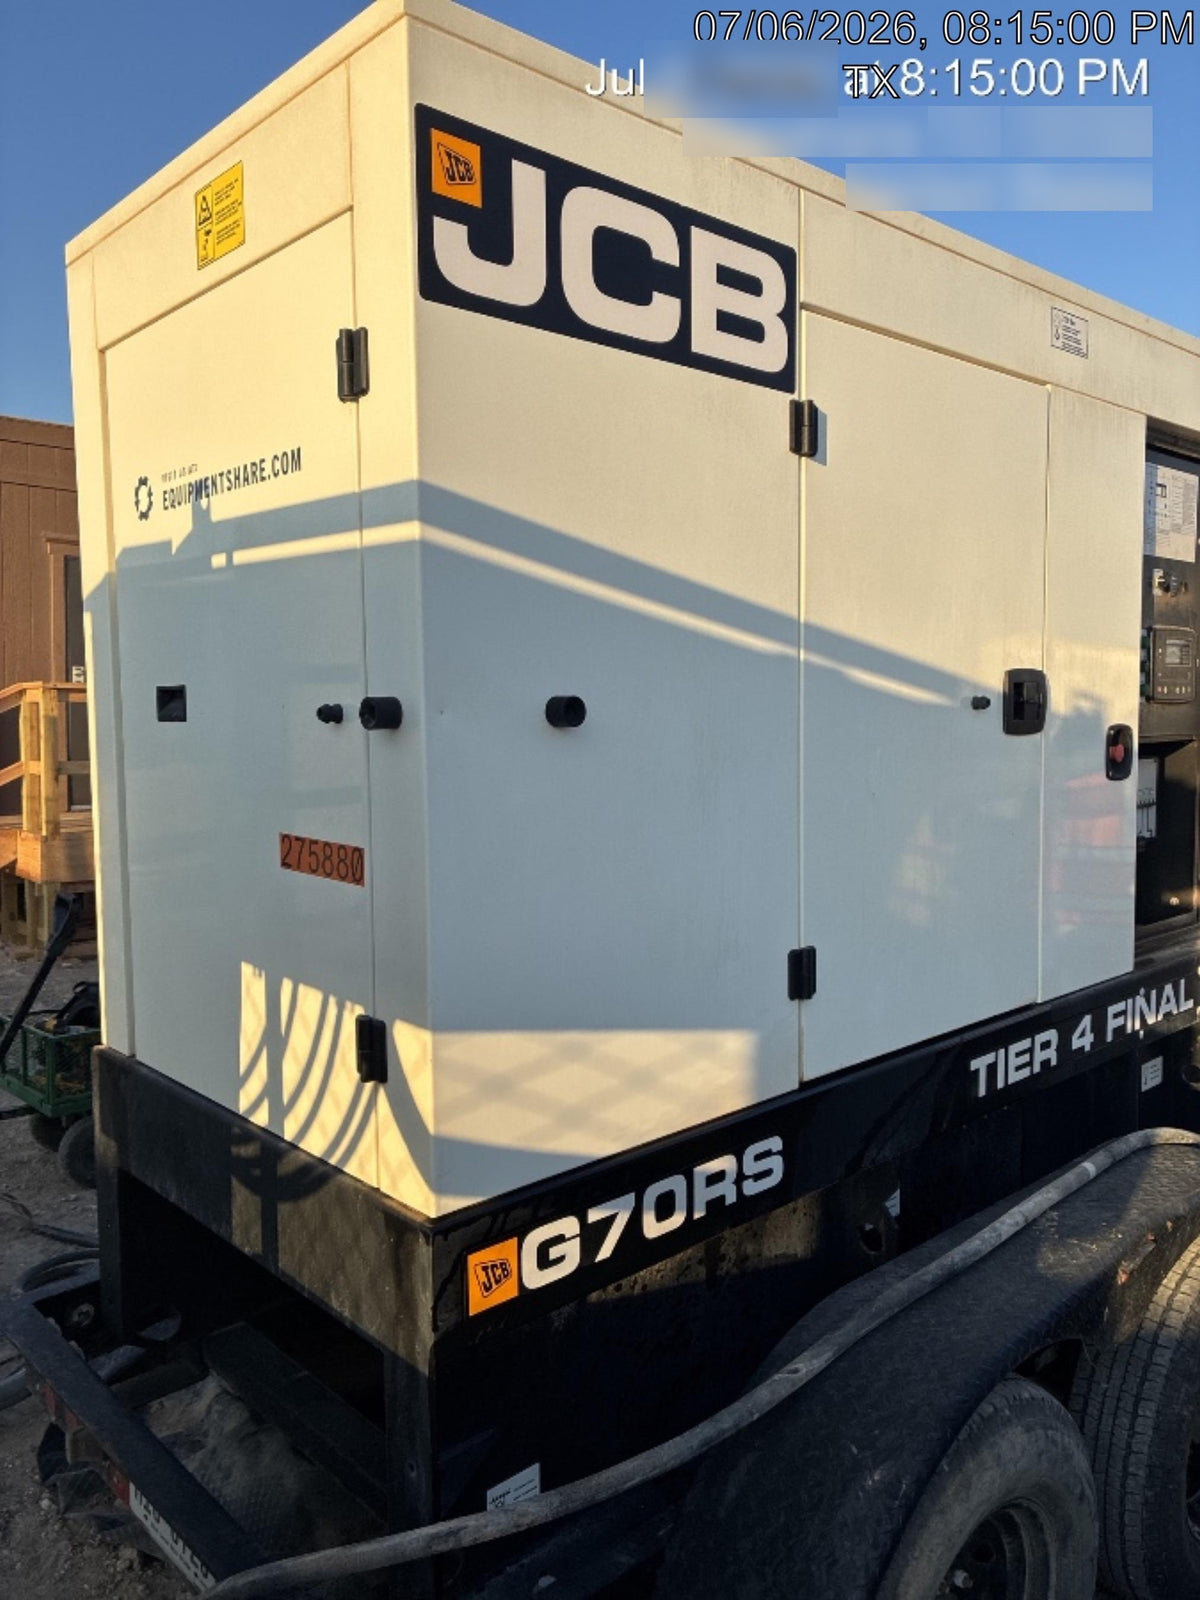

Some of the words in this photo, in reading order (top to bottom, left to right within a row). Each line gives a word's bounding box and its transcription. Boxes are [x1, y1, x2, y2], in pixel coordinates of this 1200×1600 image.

[444, 149, 475, 182] JCB
[433, 158, 788, 373] JCB
[162, 446, 302, 511] EQUIPMENTSHARE.COM
[280, 833, 364, 884] 275880
[970, 1028, 1059, 1098] TIER
[1071, 1014, 1094, 1053] 4
[1106, 977, 1195, 1042] FINAL
[520, 1135, 785, 1291] G70RS
[481, 1262, 509, 1293] JCB
